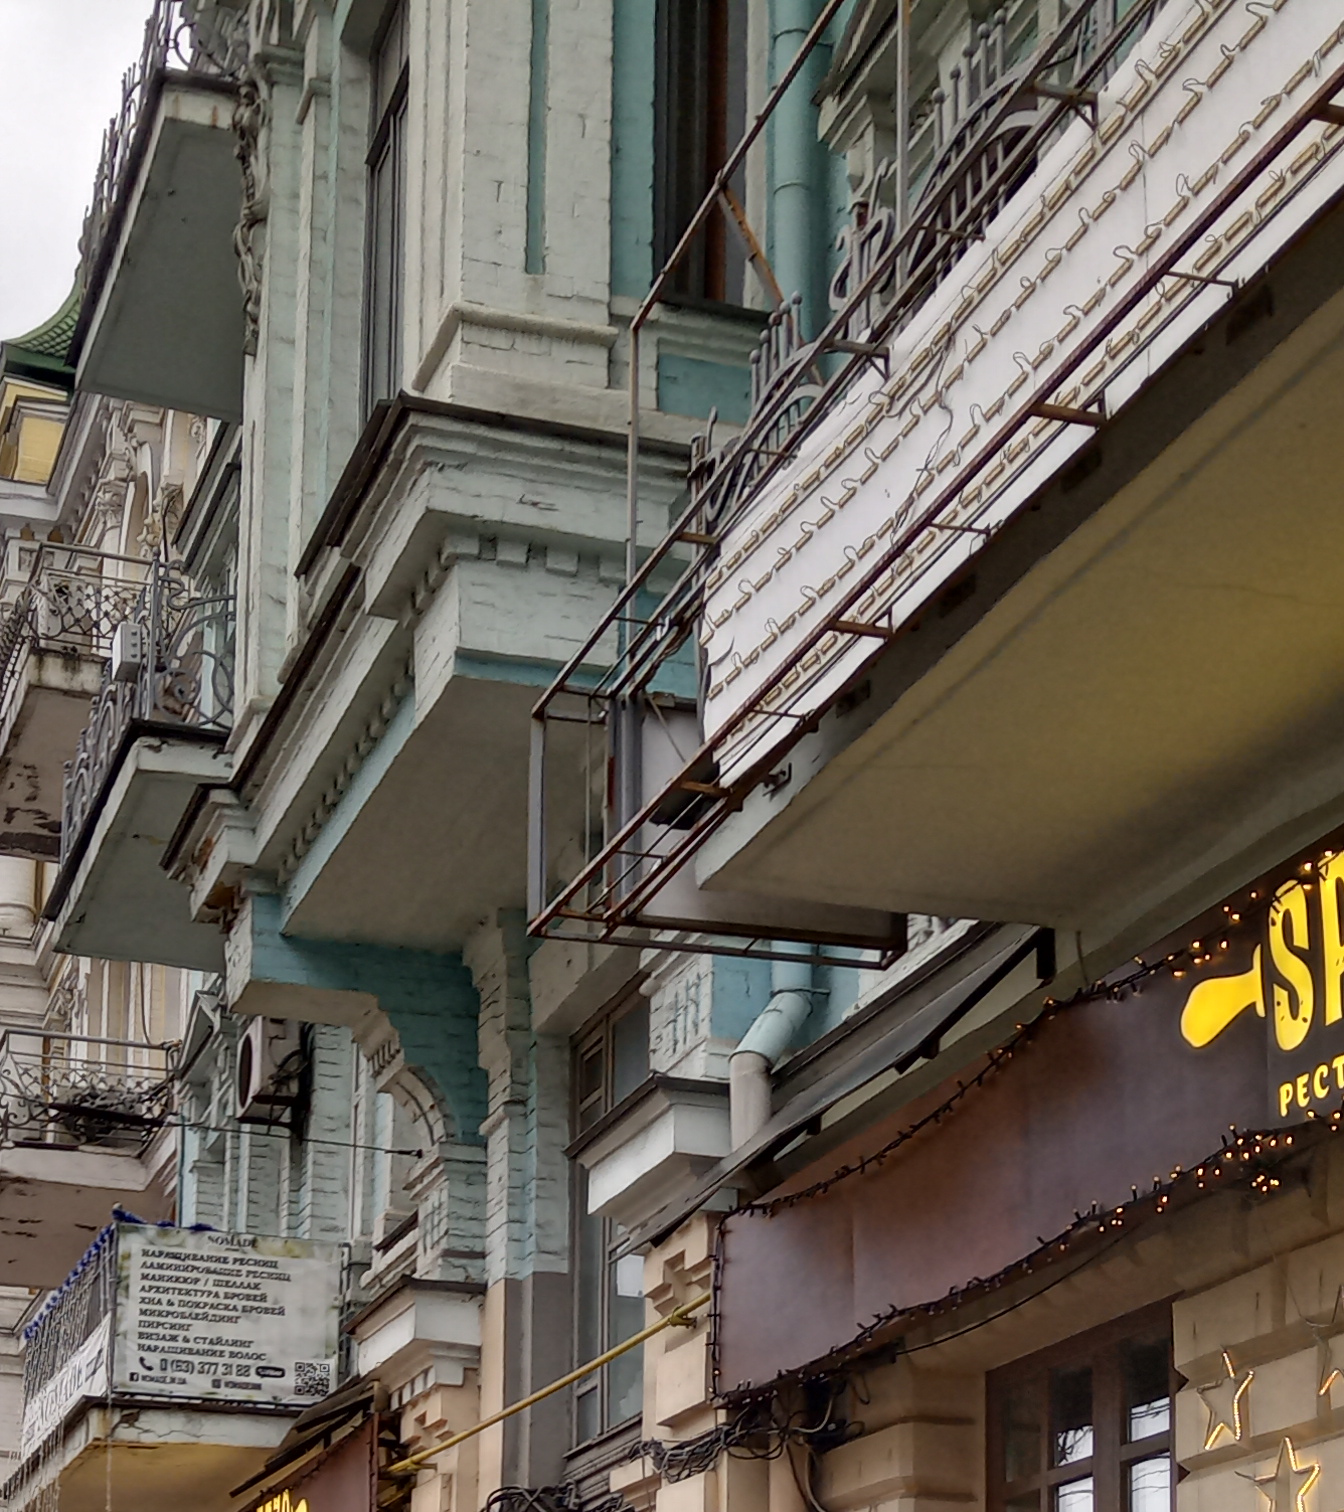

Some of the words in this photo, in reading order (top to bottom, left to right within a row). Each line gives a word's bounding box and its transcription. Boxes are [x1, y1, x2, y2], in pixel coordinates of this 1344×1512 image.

[140, 1248, 230, 1264] НАРАЩИВАНИЕ
[232, 1256, 279, 1269] РЕСНИЦ
[140, 1261, 244, 1277] ЛАМИНИРОВАНИЕ
[245, 1269, 291, 1282] РЕСНИЦ
[140, 1272, 201, 1285] МАНИКЮР
[212, 1279, 263, 1291] ШЕЛЛАК
[139, 1285, 220, 1299] АРХИТЕКТУРА
[223, 1291, 268, 1303] БРОВЕЙ
[139, 1296, 163, 1306] ХНА
[178, 1300, 239, 1312] ПОКРАСКА
[241, 1304, 286, 1317] БРОВЕЙ
[138, 1308, 241, 1324] МИКРОБЛЕЙДИНГ
[138, 1320, 193, 1332] ПИРСИНГ
[137, 1331, 180, 1343] ВИЗАЖ
[193, 1336, 254, 1349] СТАЙЛИНГ
[137, 1343, 226, 1358] НАРАЩИВАНИЕ
[228, 1350, 267, 1361] ВОЛОС
